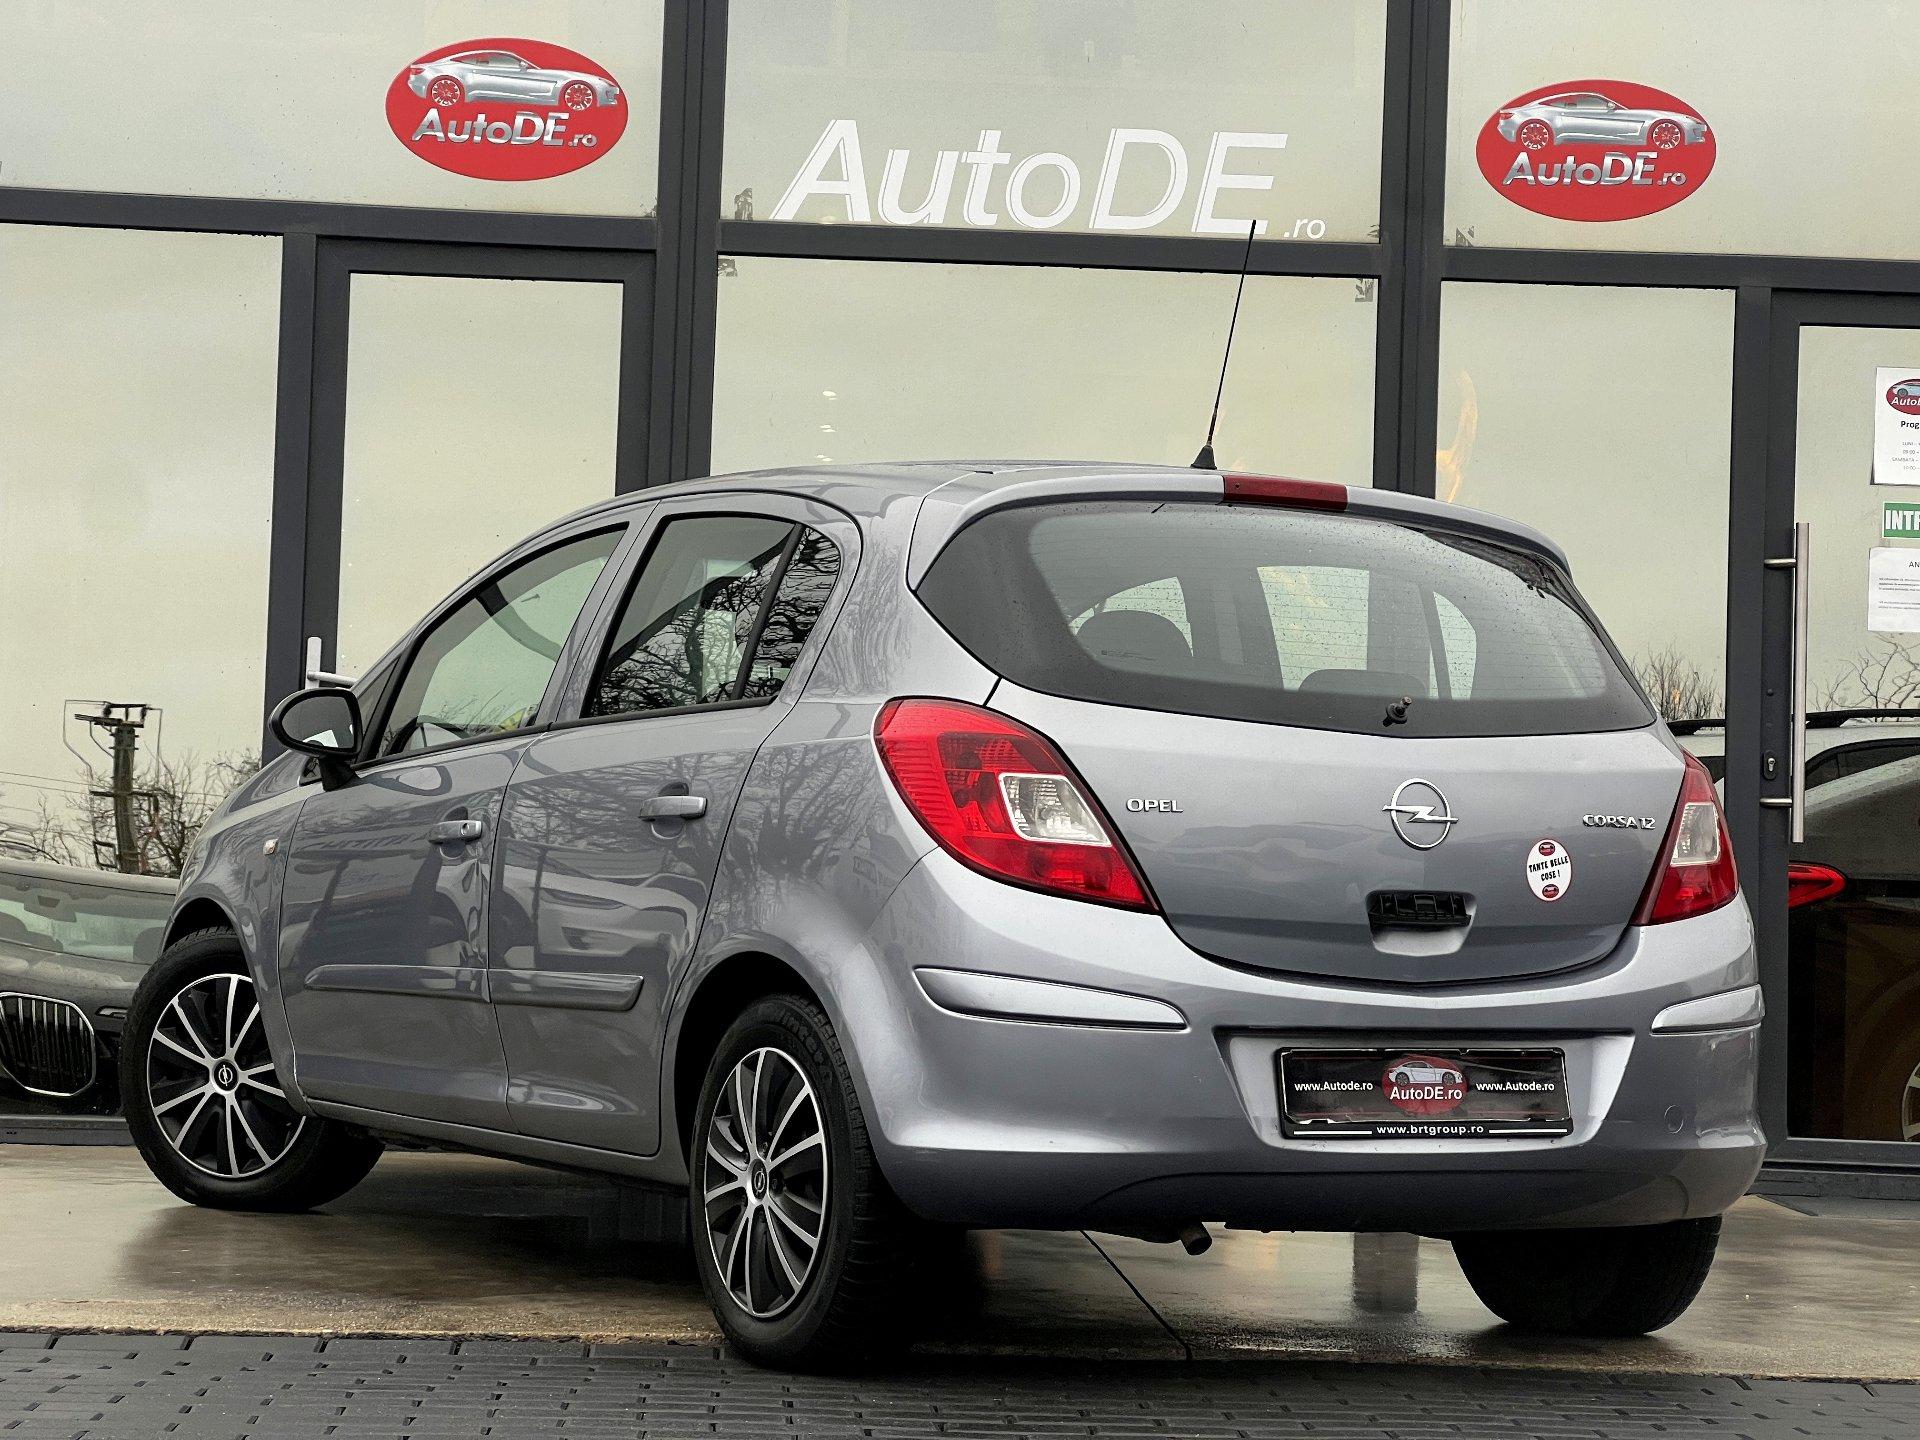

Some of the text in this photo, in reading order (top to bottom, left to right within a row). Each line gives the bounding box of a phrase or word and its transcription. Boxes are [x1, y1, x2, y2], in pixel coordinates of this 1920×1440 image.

[1126, 798, 1184, 813] OPEL
[1582, 814, 1638, 829] CORSA
[1528, 855, 1569, 873] TANTE BELLE
[1541, 870, 1556, 882] COSE
[1294, 1080, 1374, 1092] www.Autode.ro
[1476, 1080, 1555, 1092] www.Autode.ro
[1389, 1086, 1463, 1100] AutoDE.ro
[1376, 1124, 1485, 1136] www.brtgroup.ro
